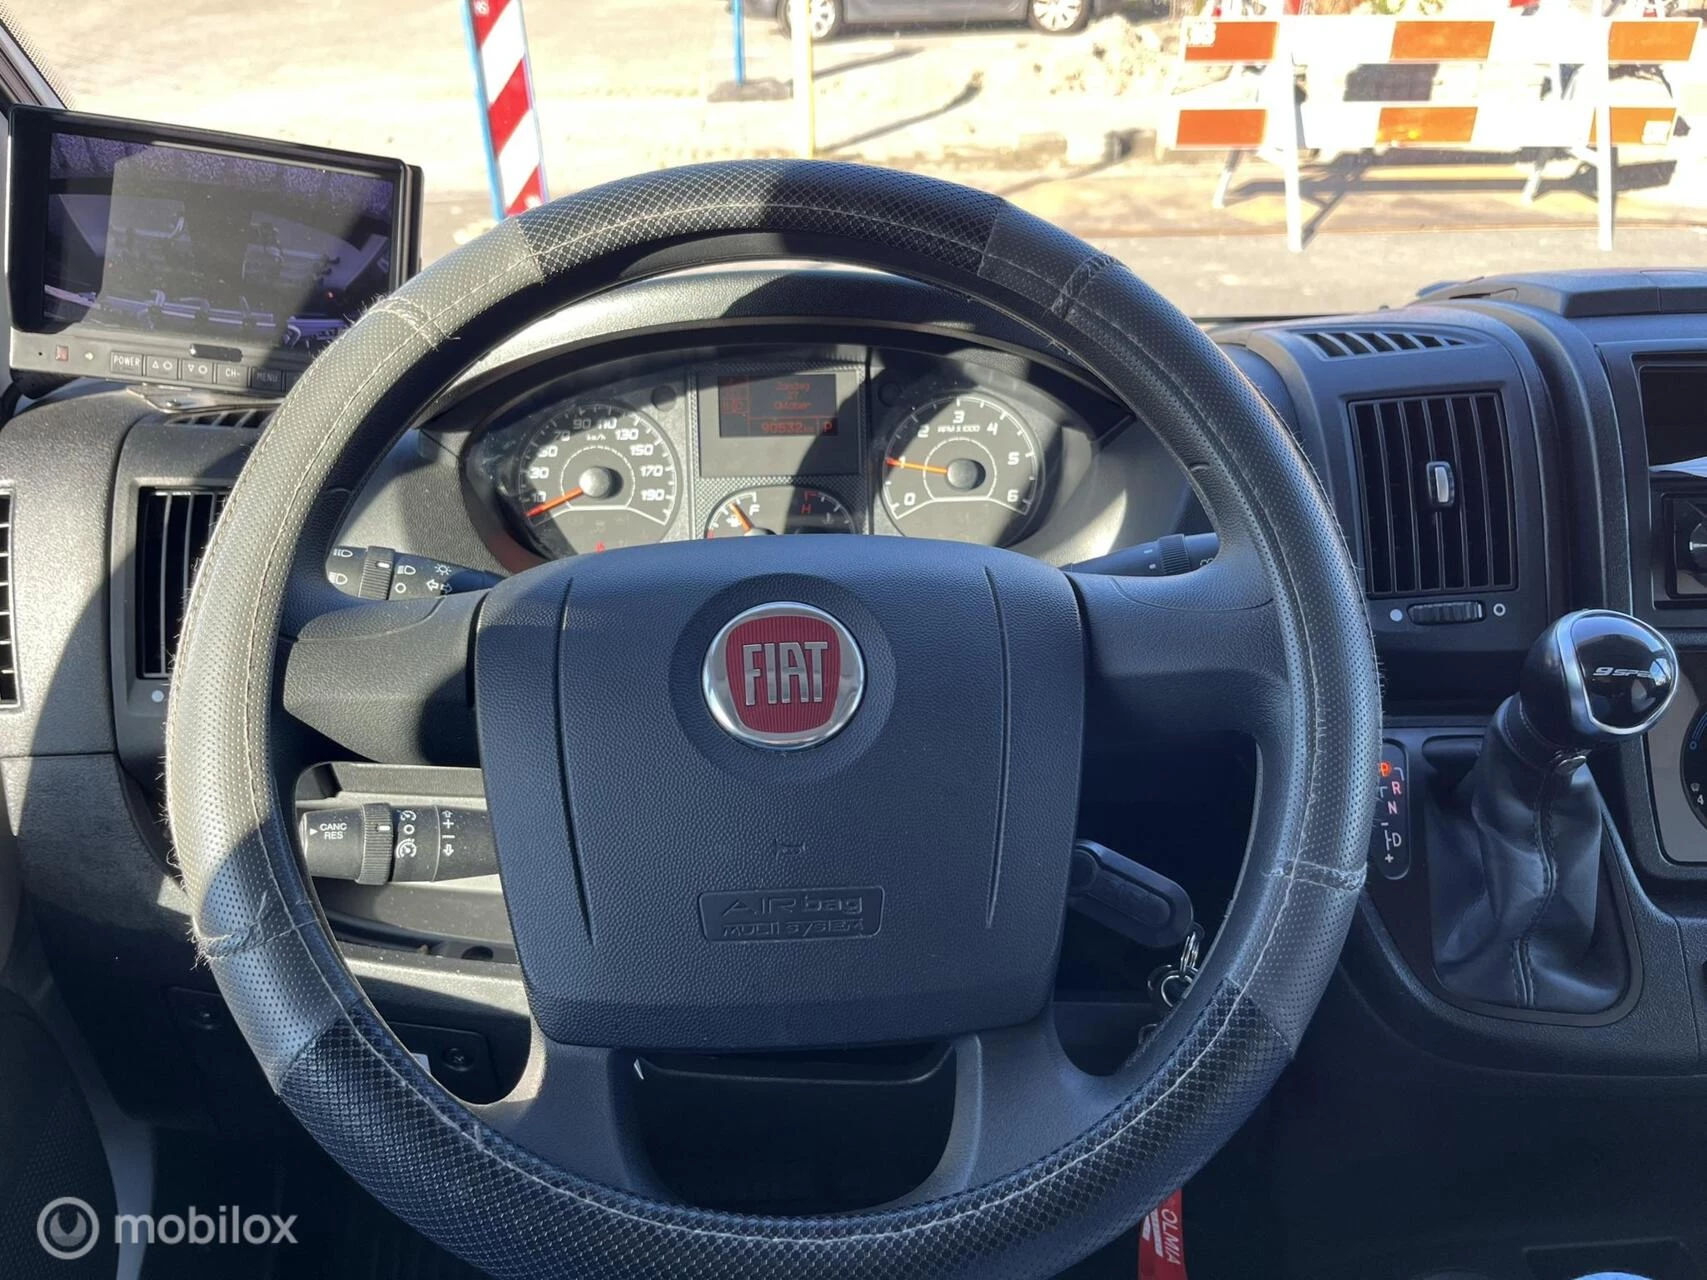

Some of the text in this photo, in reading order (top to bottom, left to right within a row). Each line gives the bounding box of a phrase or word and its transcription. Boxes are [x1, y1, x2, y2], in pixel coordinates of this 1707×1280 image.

[113, 354, 141, 367] POWER
[597, 416, 618, 430] 110
[952, 410, 965, 424] 3
[572, 418, 592, 430] 90
[824, 421, 833, 432] P
[986, 422, 998, 436] 4
[554, 430, 571, 442] 70
[614, 428, 639, 441] 130
[917, 425, 930, 438] 2
[537, 445, 559, 458] 50
[629, 444, 654, 457] 150
[1008, 451, 1020, 466] 5
[528, 467, 550, 479] 30
[639, 465, 663, 477] 170
[640, 489, 665, 501] 190
[903, 492, 916, 506] 0
[1007, 489, 1019, 502] 6
[749, 503, 760, 516] F
[801, 504, 812, 514] H
[742, 641, 829, 706] FIAT
[1593, 666, 1614, 677] 9
[1379, 762, 1390, 777] P
[1391, 781, 1402, 796] R
[1696, 794, 1705, 806] 4
[1387, 801, 1398, 815] N
[319, 822, 348, 832] CANC
[324, 831, 344, 840] RES
[1391, 832, 1402, 848] D
